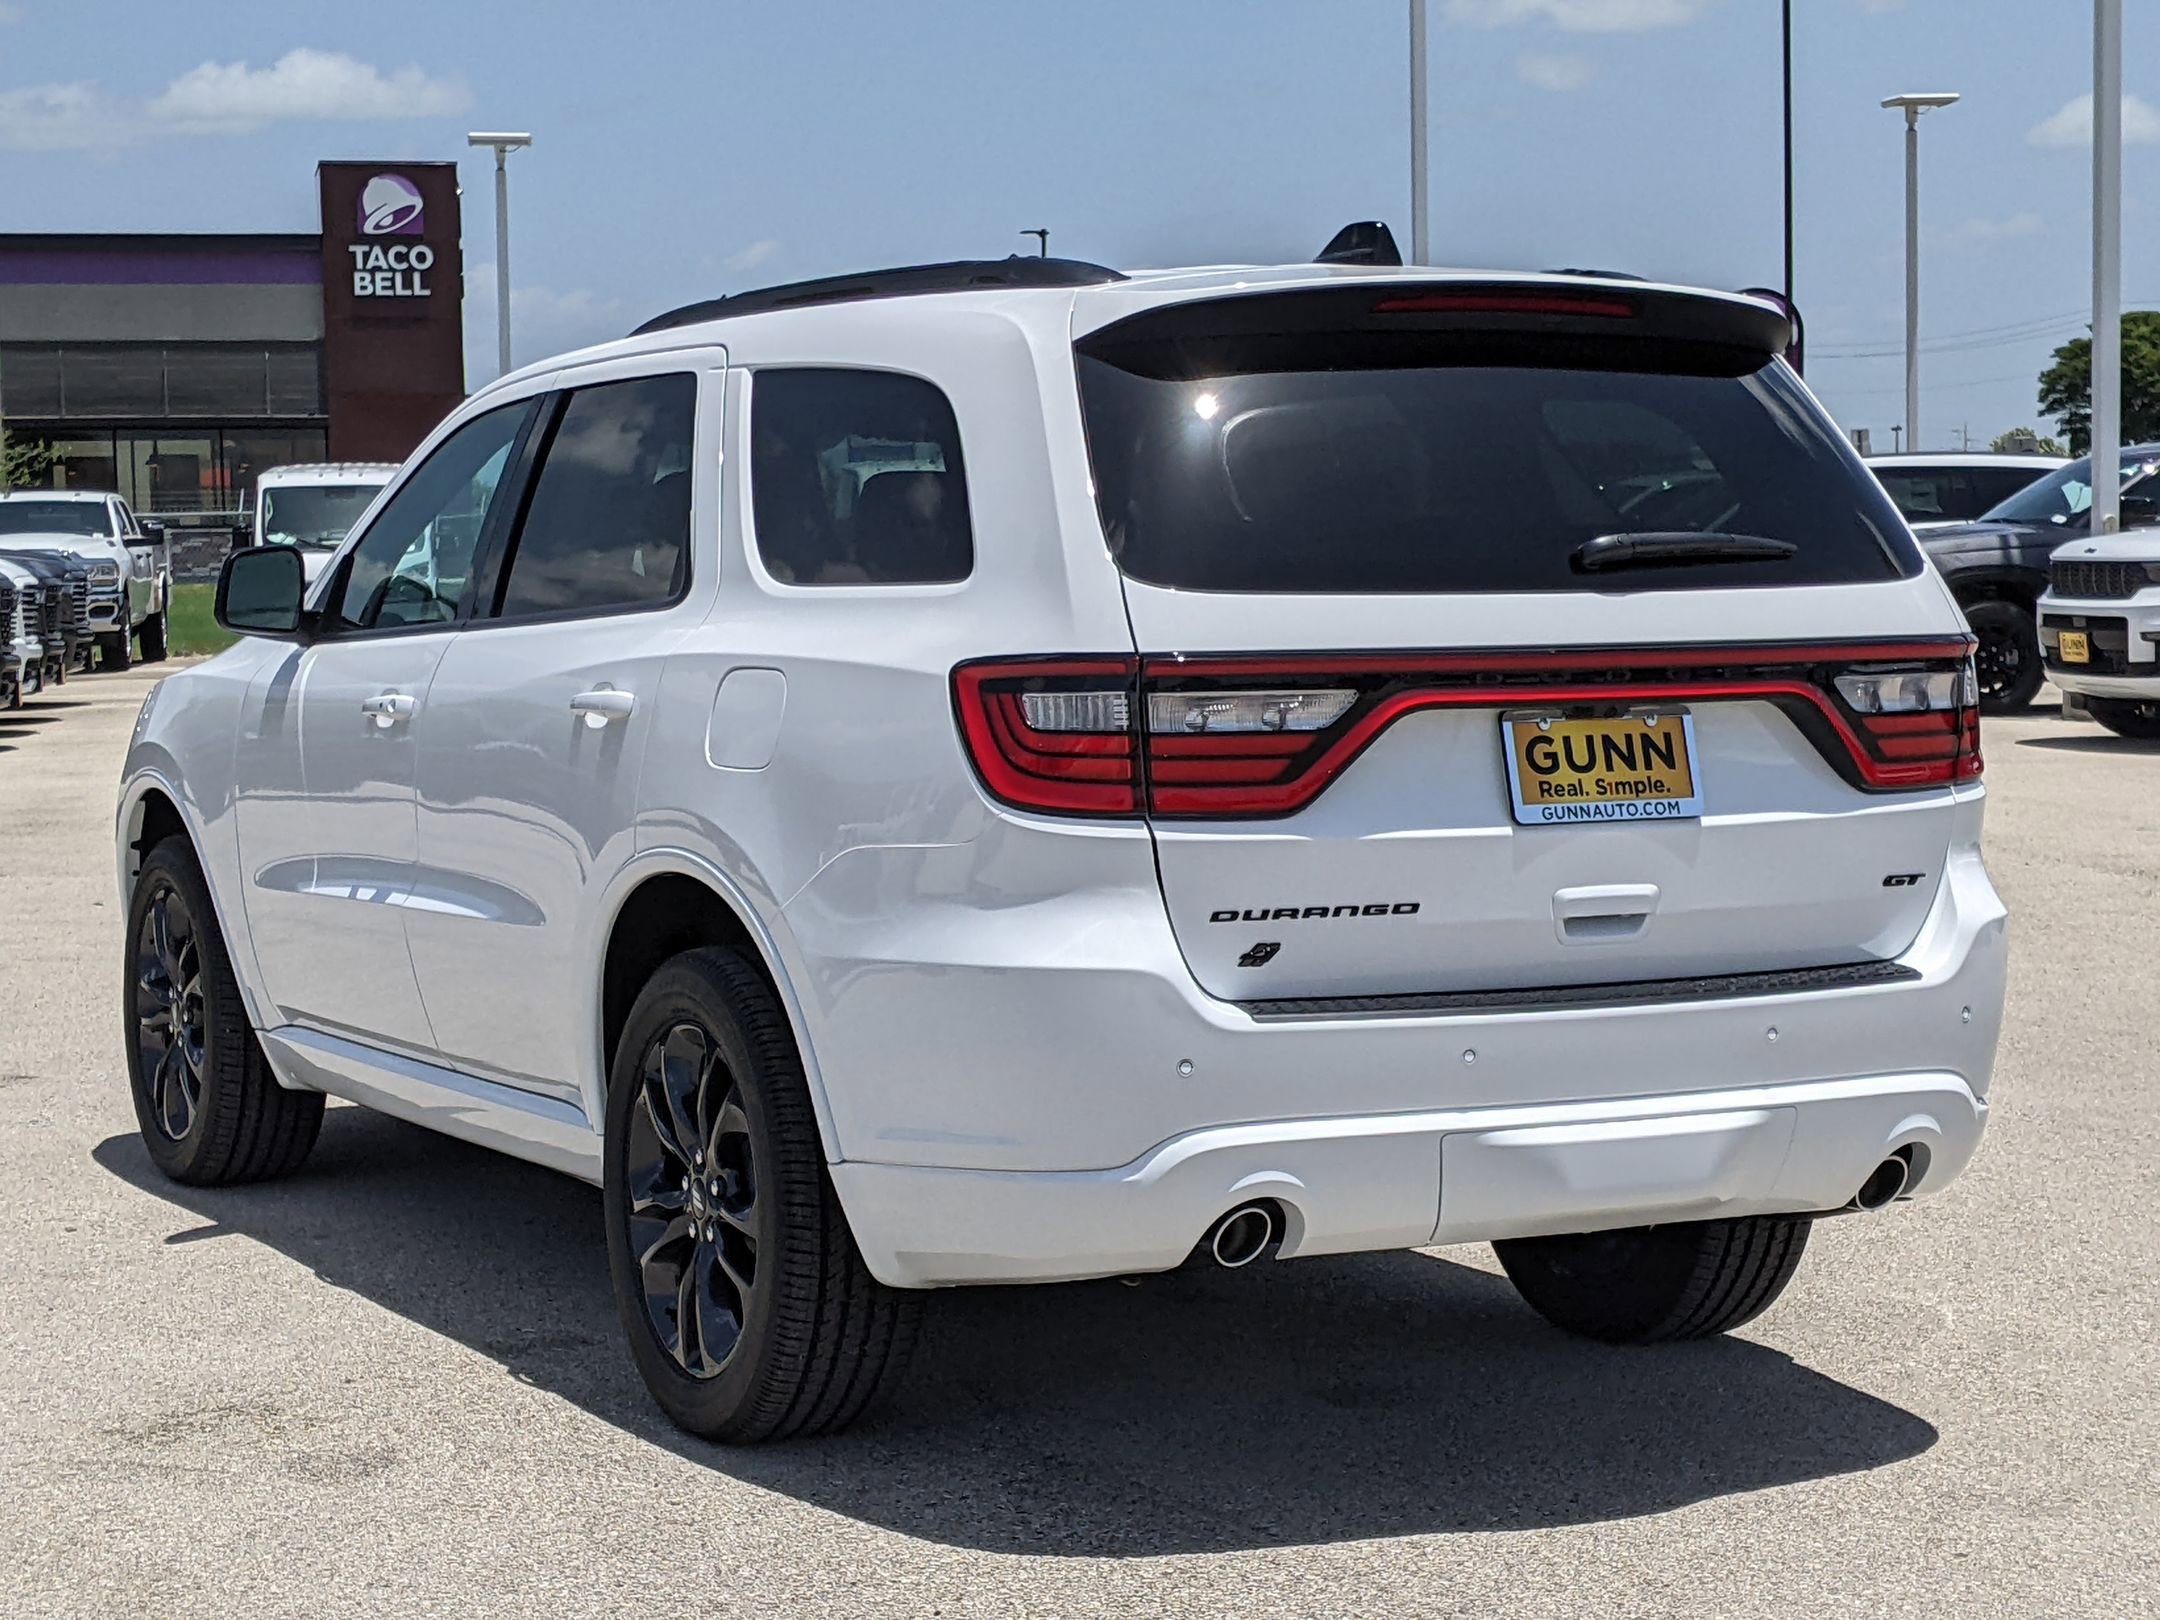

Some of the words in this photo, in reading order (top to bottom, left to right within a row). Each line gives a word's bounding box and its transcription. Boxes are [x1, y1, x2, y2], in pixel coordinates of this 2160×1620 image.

[348, 244, 434, 270] TACO
[353, 271, 432, 296] BELL
[1525, 732, 1676, 775] GUNN
[1538, 778, 1590, 798] Real.
[1541, 801, 1681, 820] GUNNAUTO.COM
[1882, 873, 1926, 887] GT
[1209, 902, 1420, 923] DURANGO
